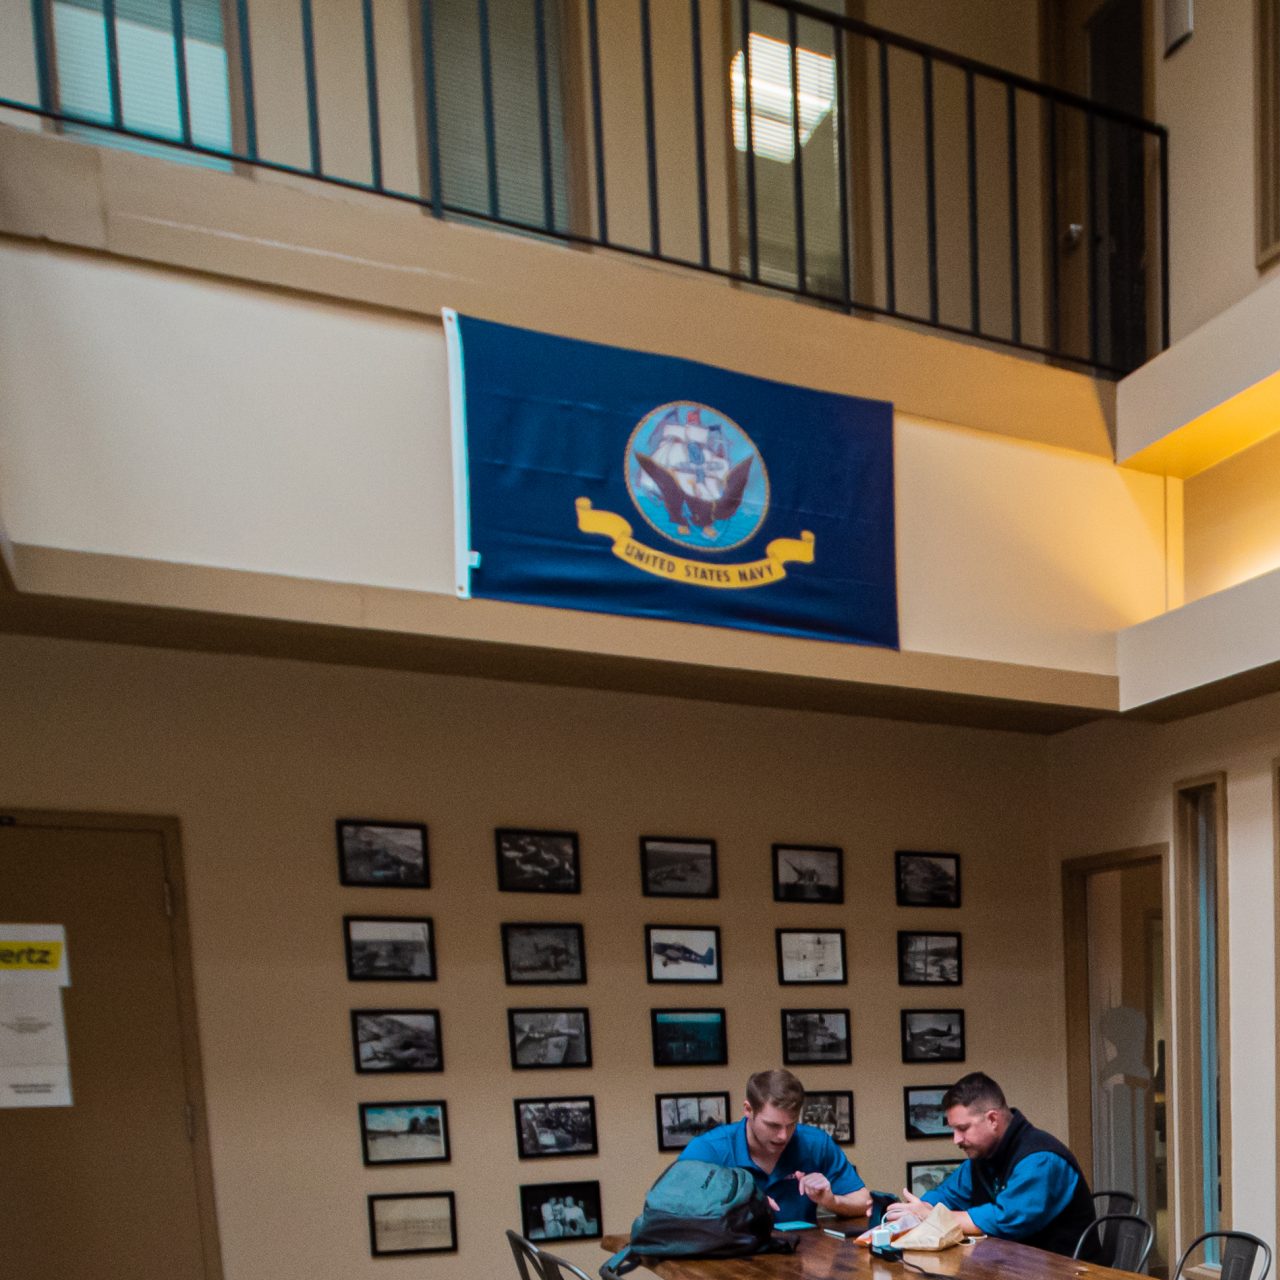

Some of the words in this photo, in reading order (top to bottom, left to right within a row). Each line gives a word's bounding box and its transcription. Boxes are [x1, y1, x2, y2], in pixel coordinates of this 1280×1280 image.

[625, 544, 676, 573] UNITED
[685, 565, 730, 582] STATES
[738, 564, 774, 583] NAVY
